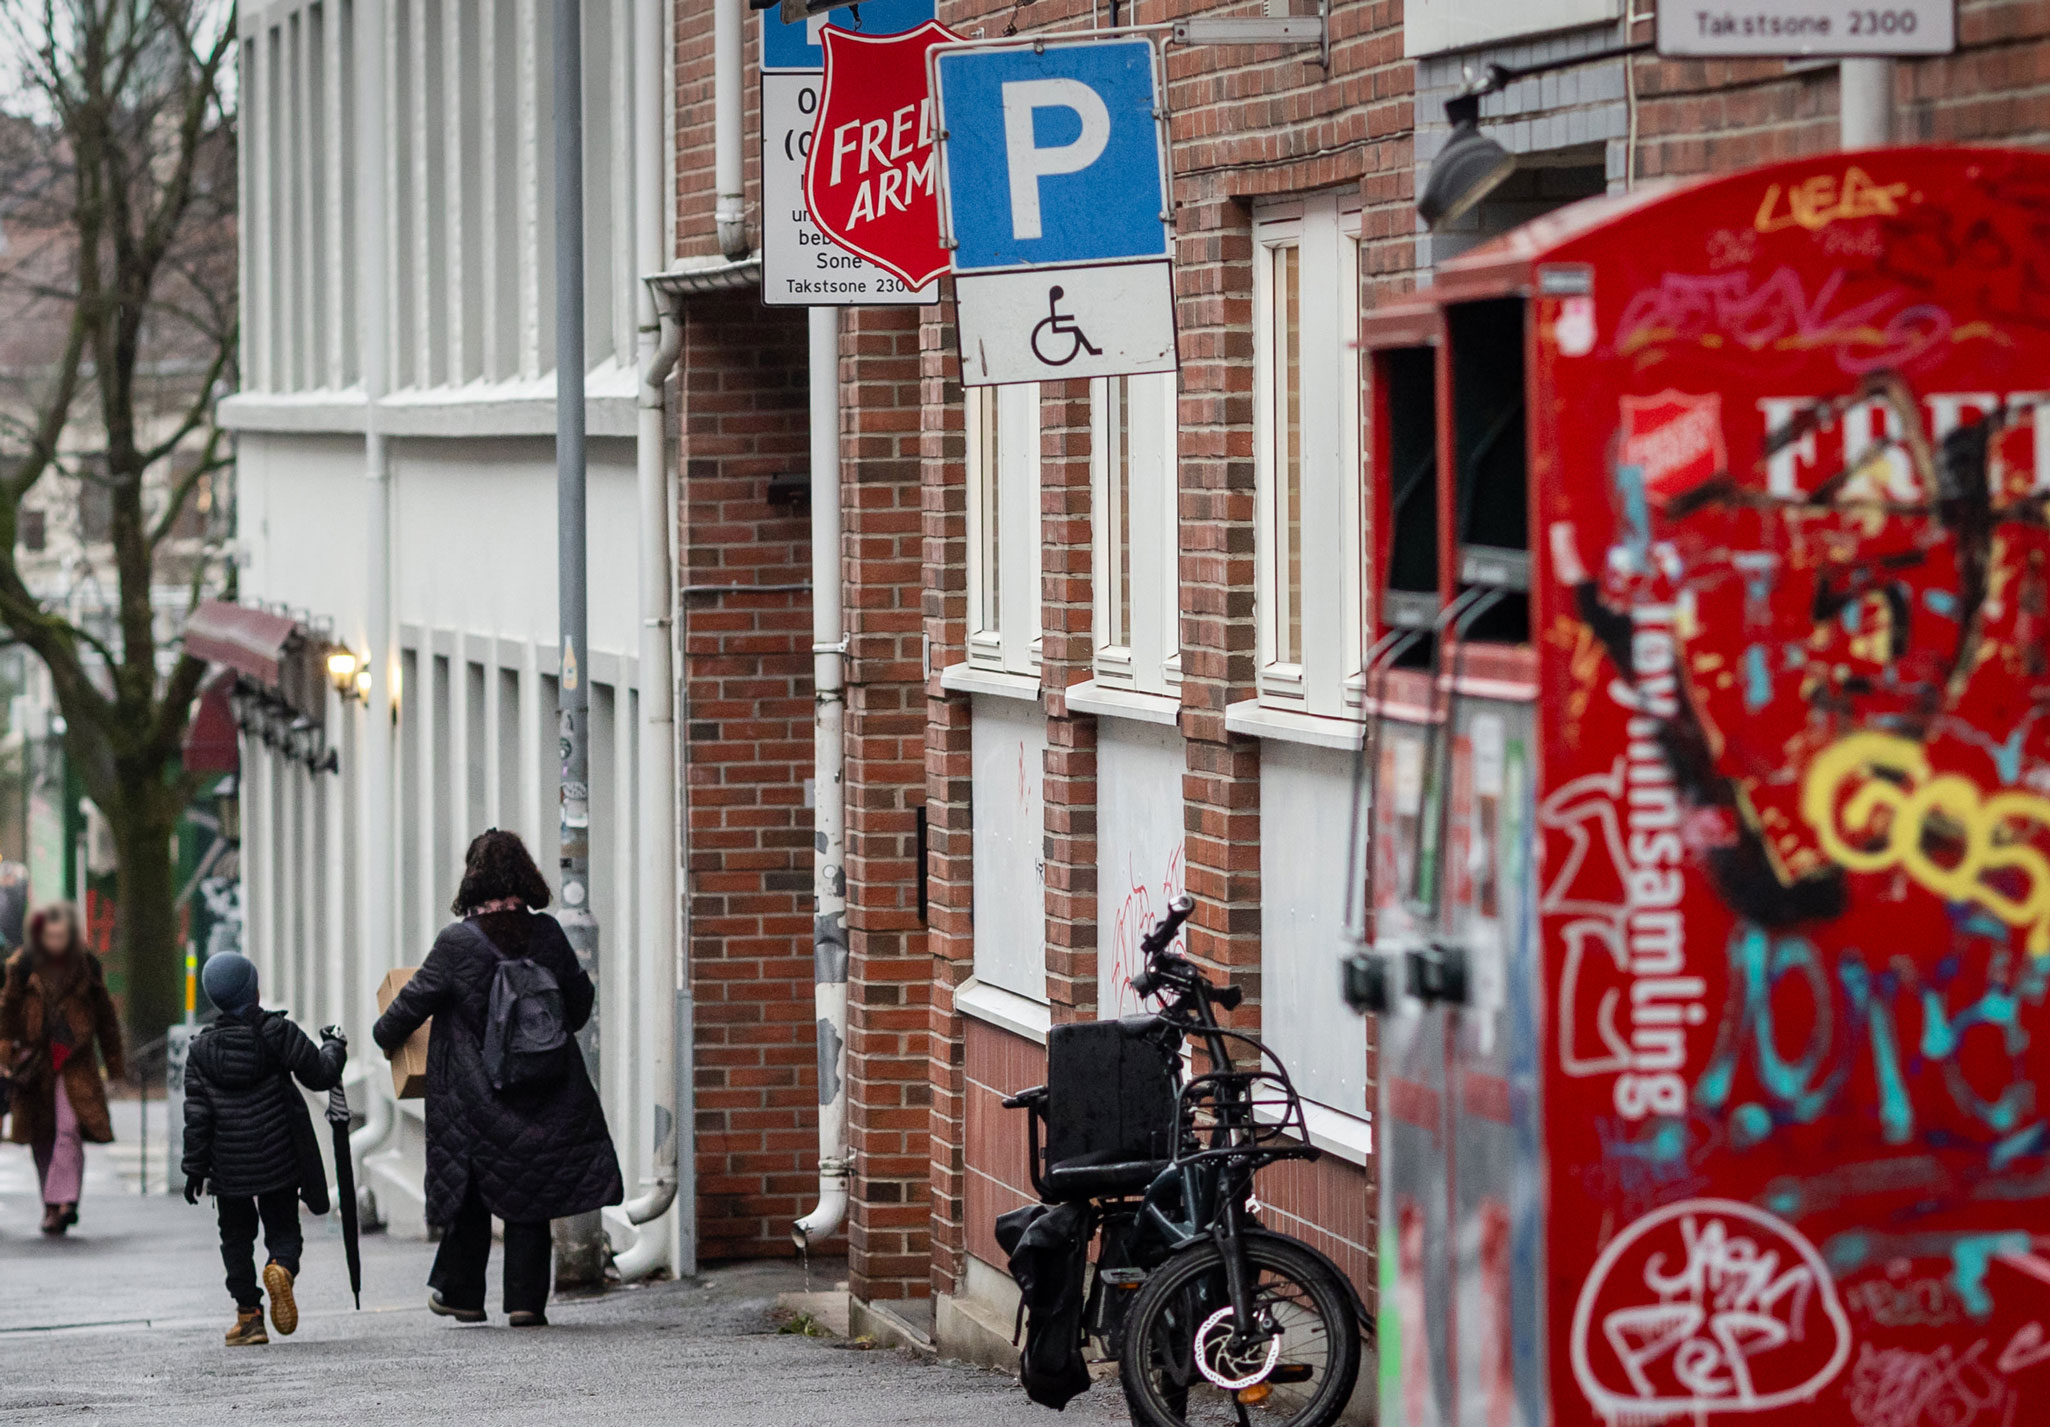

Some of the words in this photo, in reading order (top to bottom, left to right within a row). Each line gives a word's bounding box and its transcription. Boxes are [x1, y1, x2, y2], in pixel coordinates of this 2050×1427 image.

[1694, 10, 1832, 37] Takstsone
[1848, 9, 1918, 36] 2300
[829, 97, 934, 187] FREL
[1001, 77, 1111, 240] P
[845, 151, 935, 232] ARM
[799, 229, 833, 246] beb
[816, 252, 863, 269] Sone
[786, 278, 867, 293] Takstsone
[876, 278, 906, 293] 230
